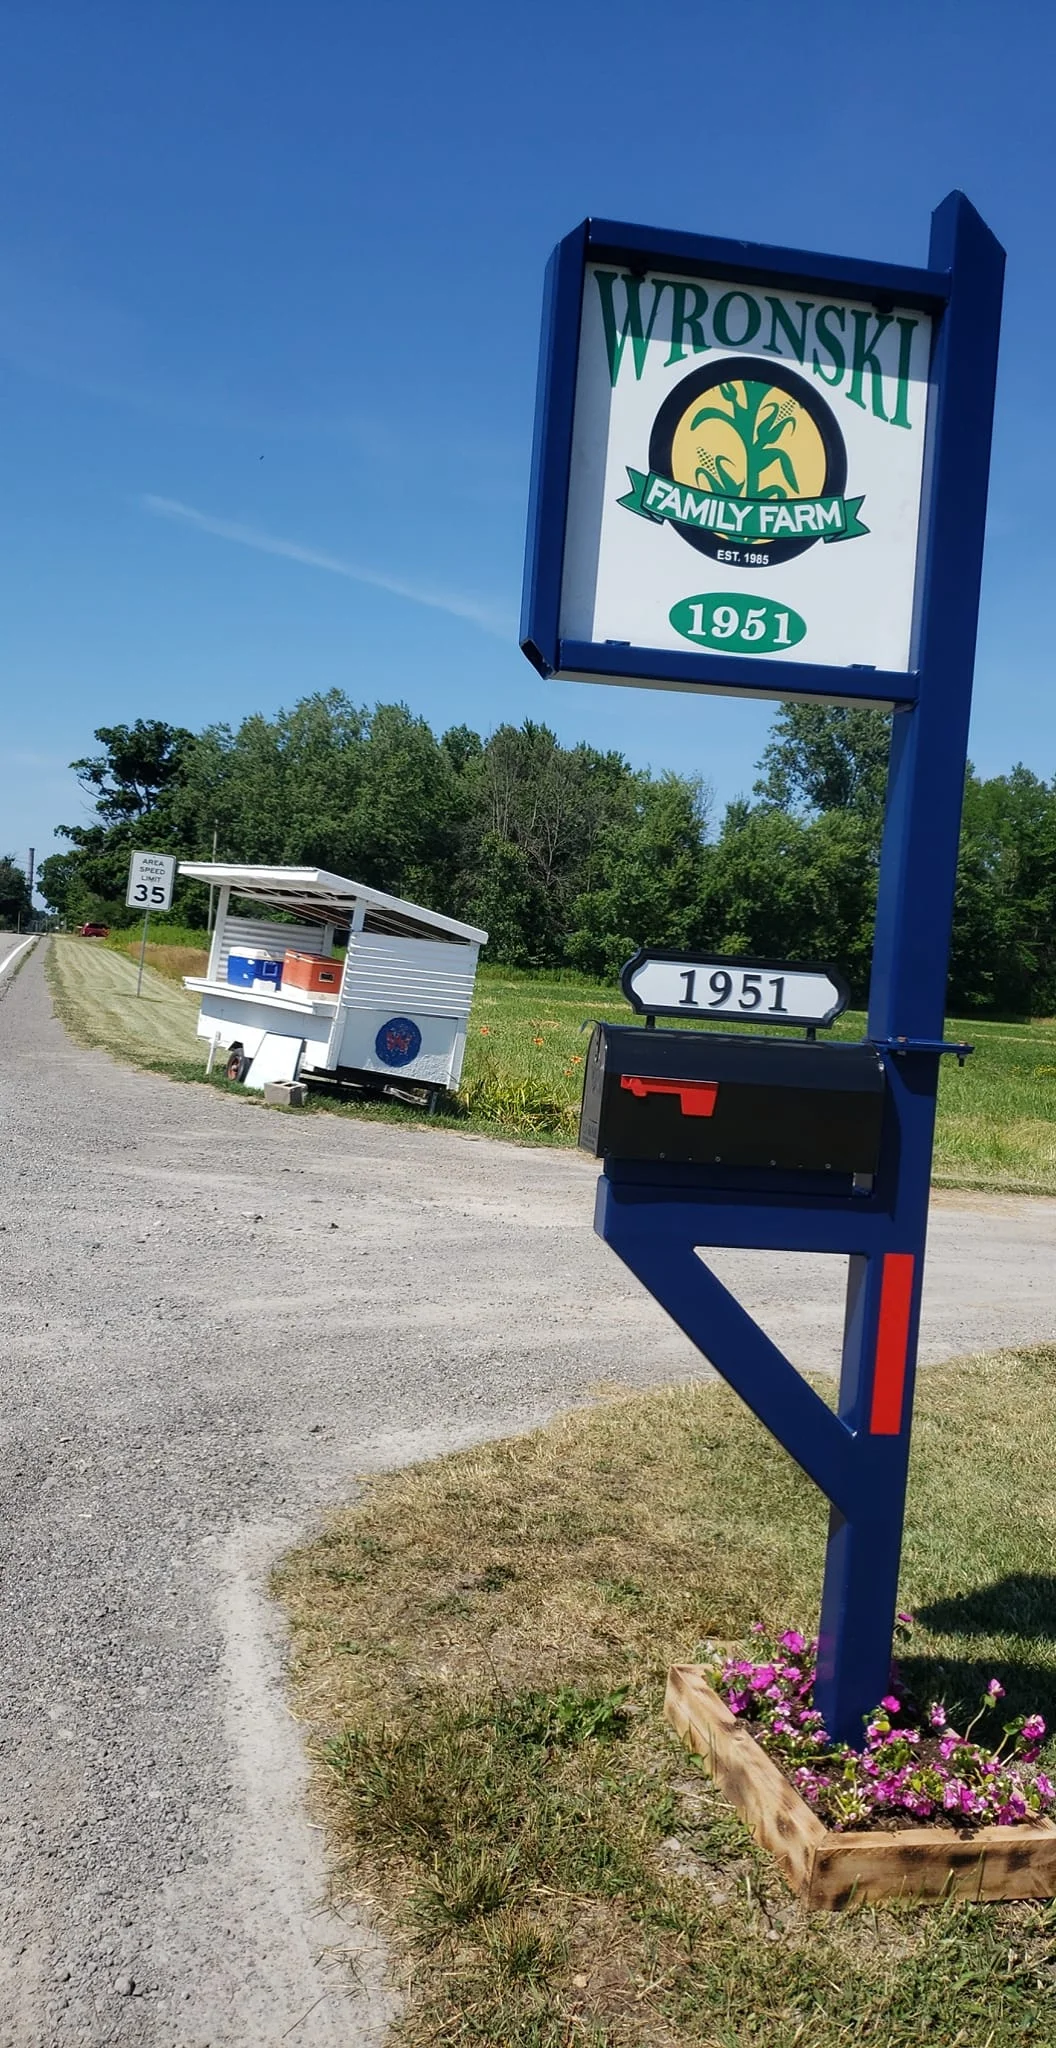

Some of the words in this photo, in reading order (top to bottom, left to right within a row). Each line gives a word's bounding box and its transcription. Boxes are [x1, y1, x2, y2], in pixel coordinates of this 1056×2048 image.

[594, 270, 919, 430] WRONSKI
[646, 478, 753, 532] FAMILY
[759, 500, 842, 533] FARM
[717, 549, 741, 562] EST.
[744, 553, 769, 565] 1985
[687, 603, 792, 644] 1951
[140, 866, 166, 875] SPEED
[142, 858, 164, 867] AREA
[141, 875, 162, 883] LIMIT
[134, 884, 165, 904] 35
[679, 969, 788, 1012] 1951
